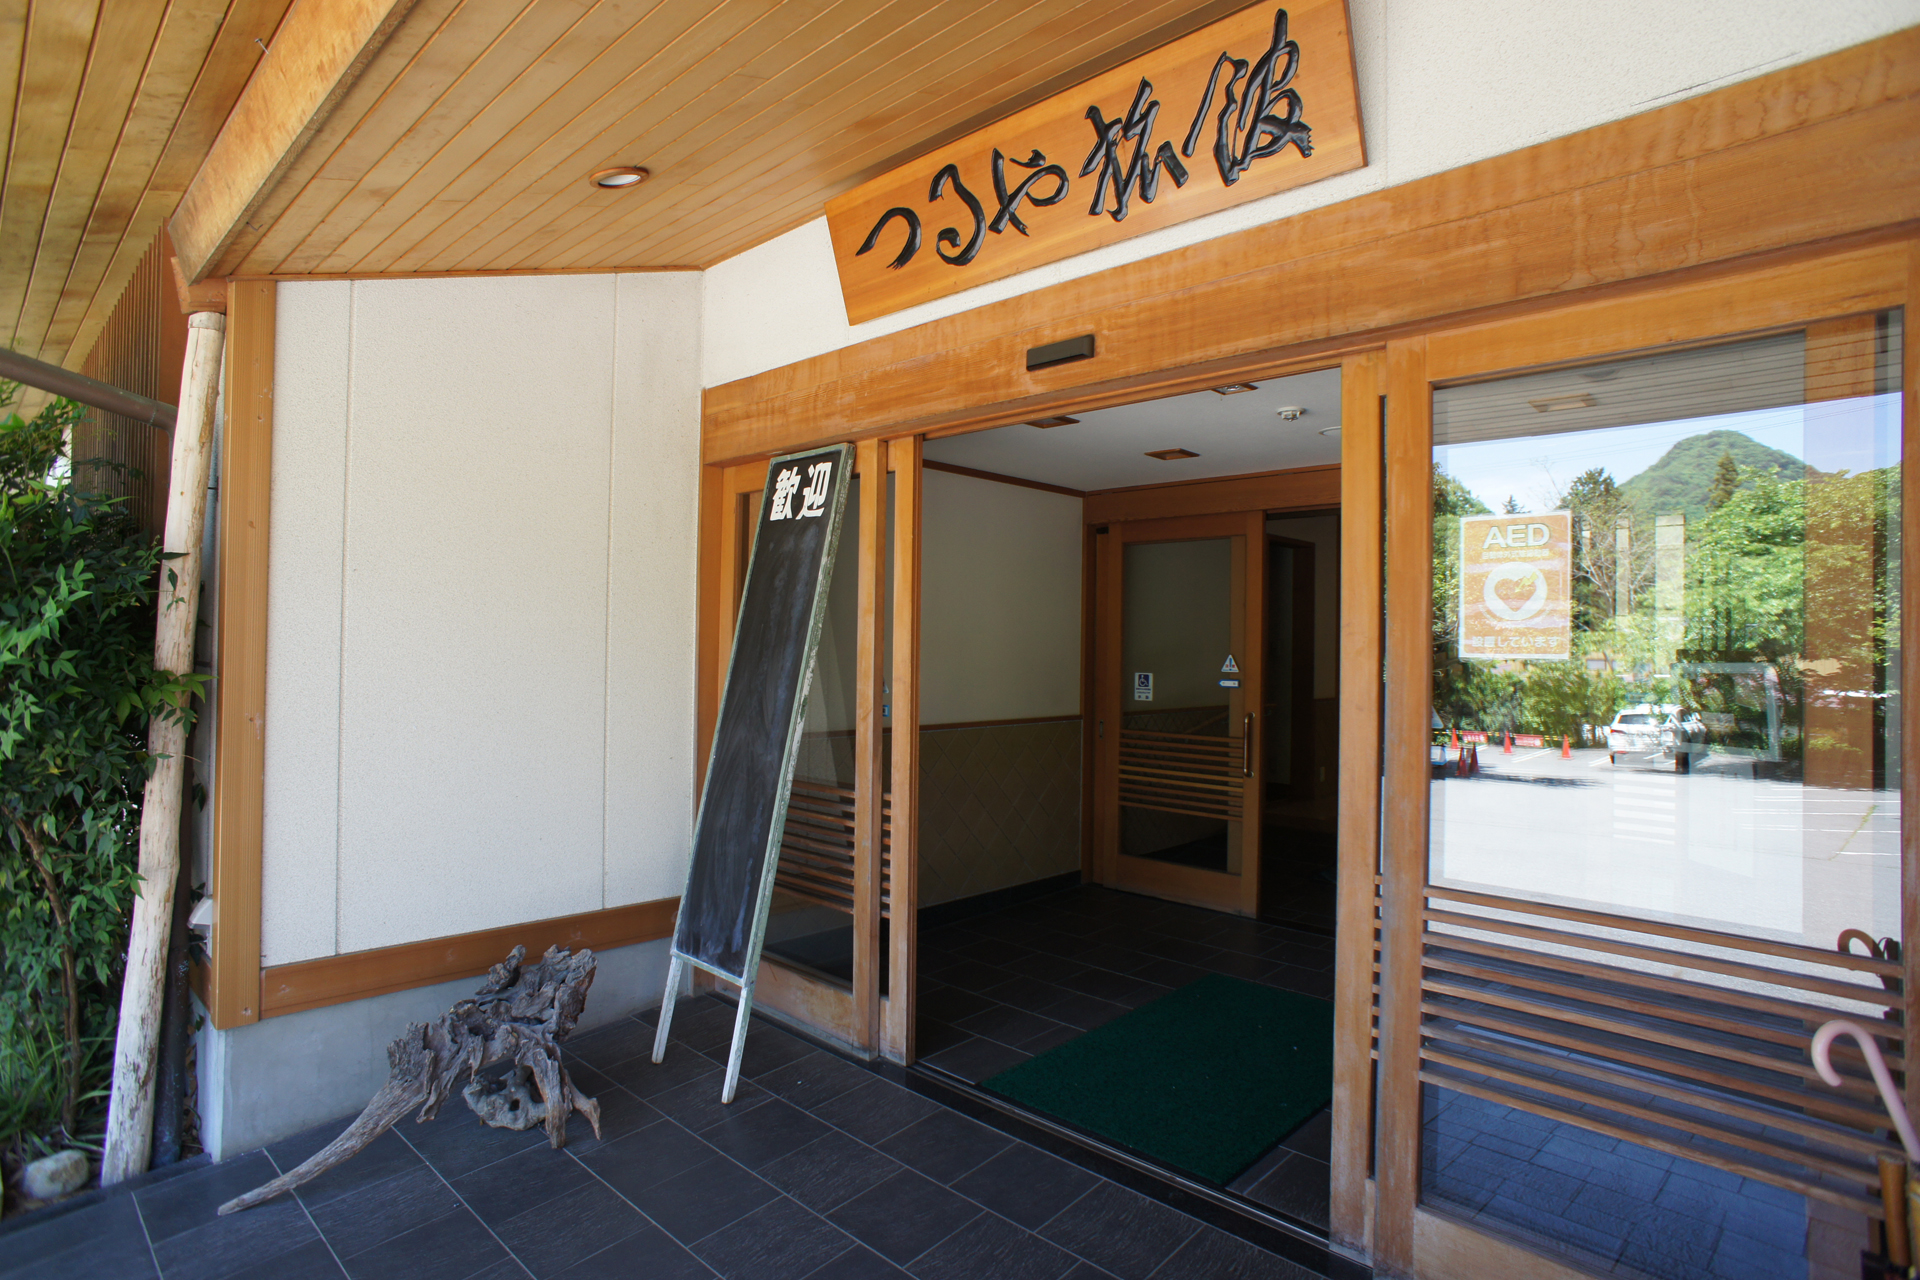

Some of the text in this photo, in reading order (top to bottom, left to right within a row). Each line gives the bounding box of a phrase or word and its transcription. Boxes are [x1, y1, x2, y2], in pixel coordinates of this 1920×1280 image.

[769, 462, 833, 521] 歓迎
[1482, 522, 1550, 549] AED
[1471, 635, 1560, 648] 設置しています
